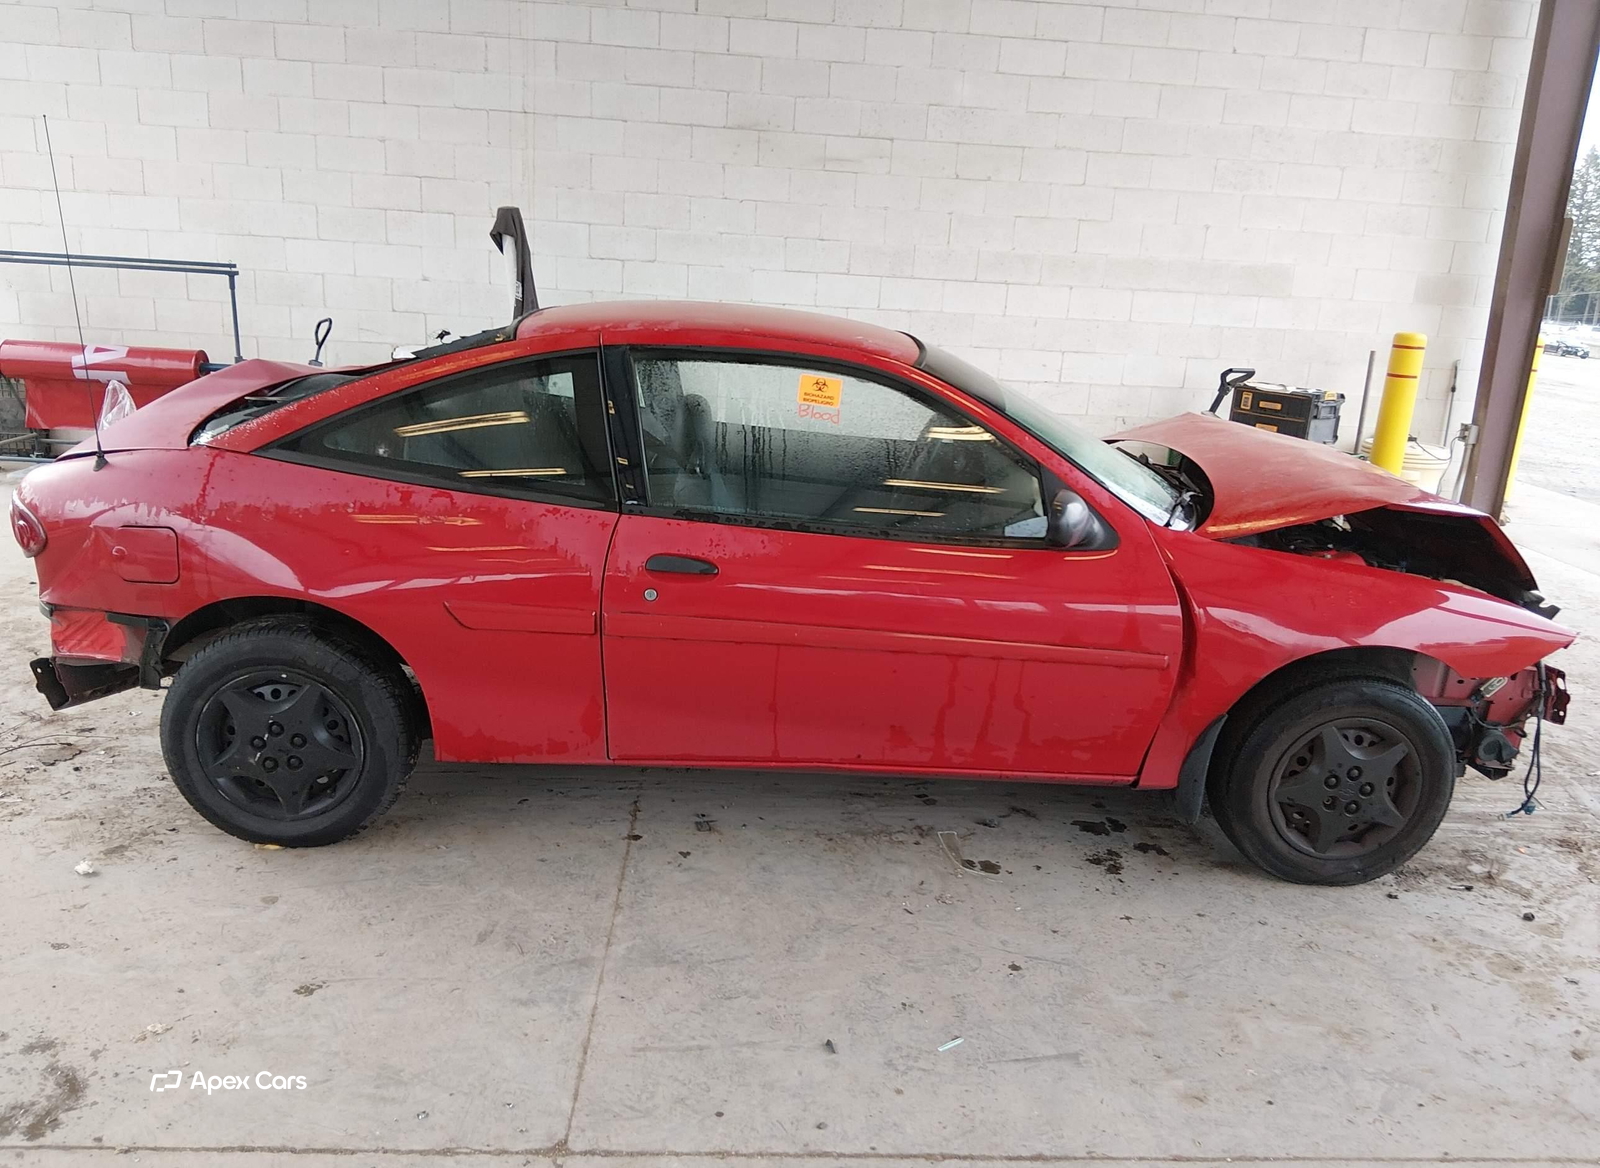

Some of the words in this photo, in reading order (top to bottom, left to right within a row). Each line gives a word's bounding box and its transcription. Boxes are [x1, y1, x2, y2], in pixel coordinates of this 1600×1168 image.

[804, 392, 834, 401] BIOHAZARD
[803, 398, 834, 406] BIOPELIGRO
[798, 403, 840, 425] Blood
